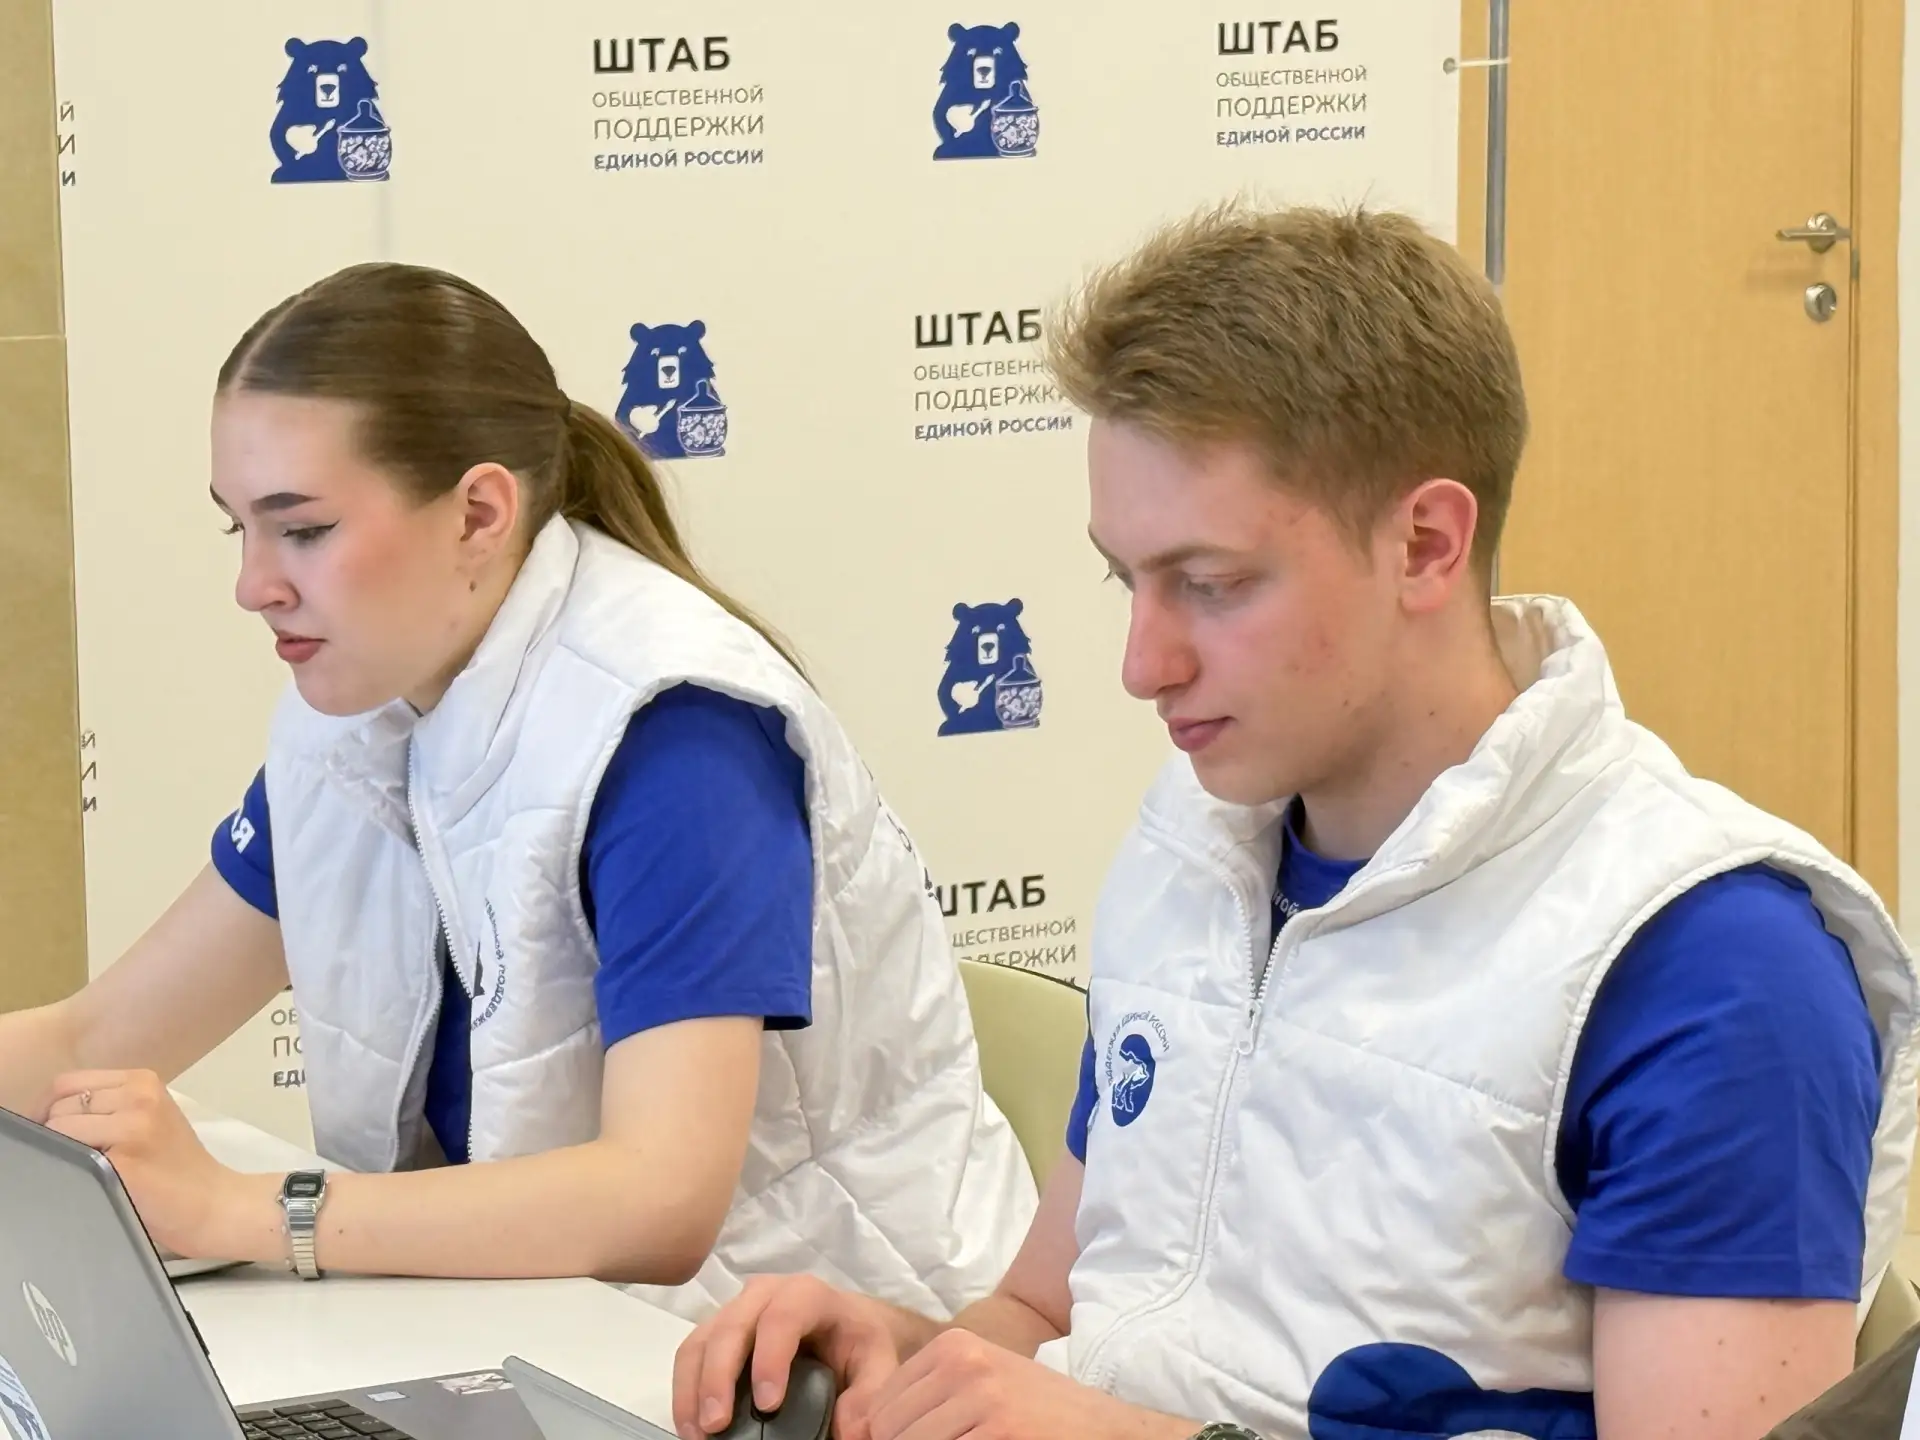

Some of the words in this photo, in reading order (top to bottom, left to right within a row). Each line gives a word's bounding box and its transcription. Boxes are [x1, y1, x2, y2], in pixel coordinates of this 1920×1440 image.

[1218, 19, 1339, 55] ШТАБ
[594, 36, 730, 74] ШТАБ
[1216, 64, 1367, 88] ОБЩЕСТВЕННОЙ
[592, 84, 764, 110] ОБЩЕСТВЕННОЙ
[1216, 92, 1367, 120] ПОДДЕРЖКИ
[594, 114, 764, 142] ПОДДЕРЖКИ
[1216, 125, 1290, 148] ЕДИНОЙ
[1295, 125, 1365, 143] РОССИИ
[594, 148, 678, 172] ЕДИНОЙ
[684, 149, 764, 167] РОССИИ
[915, 308, 1042, 349] ШТАБ
[914, 359, 1044, 381] ОБЩЕСТВЕНН
[915, 384, 1064, 412] ПОДДЕРЖК
[915, 418, 993, 442] ЕДИНОЙ
[999, 415, 1073, 434] РОССИИ
